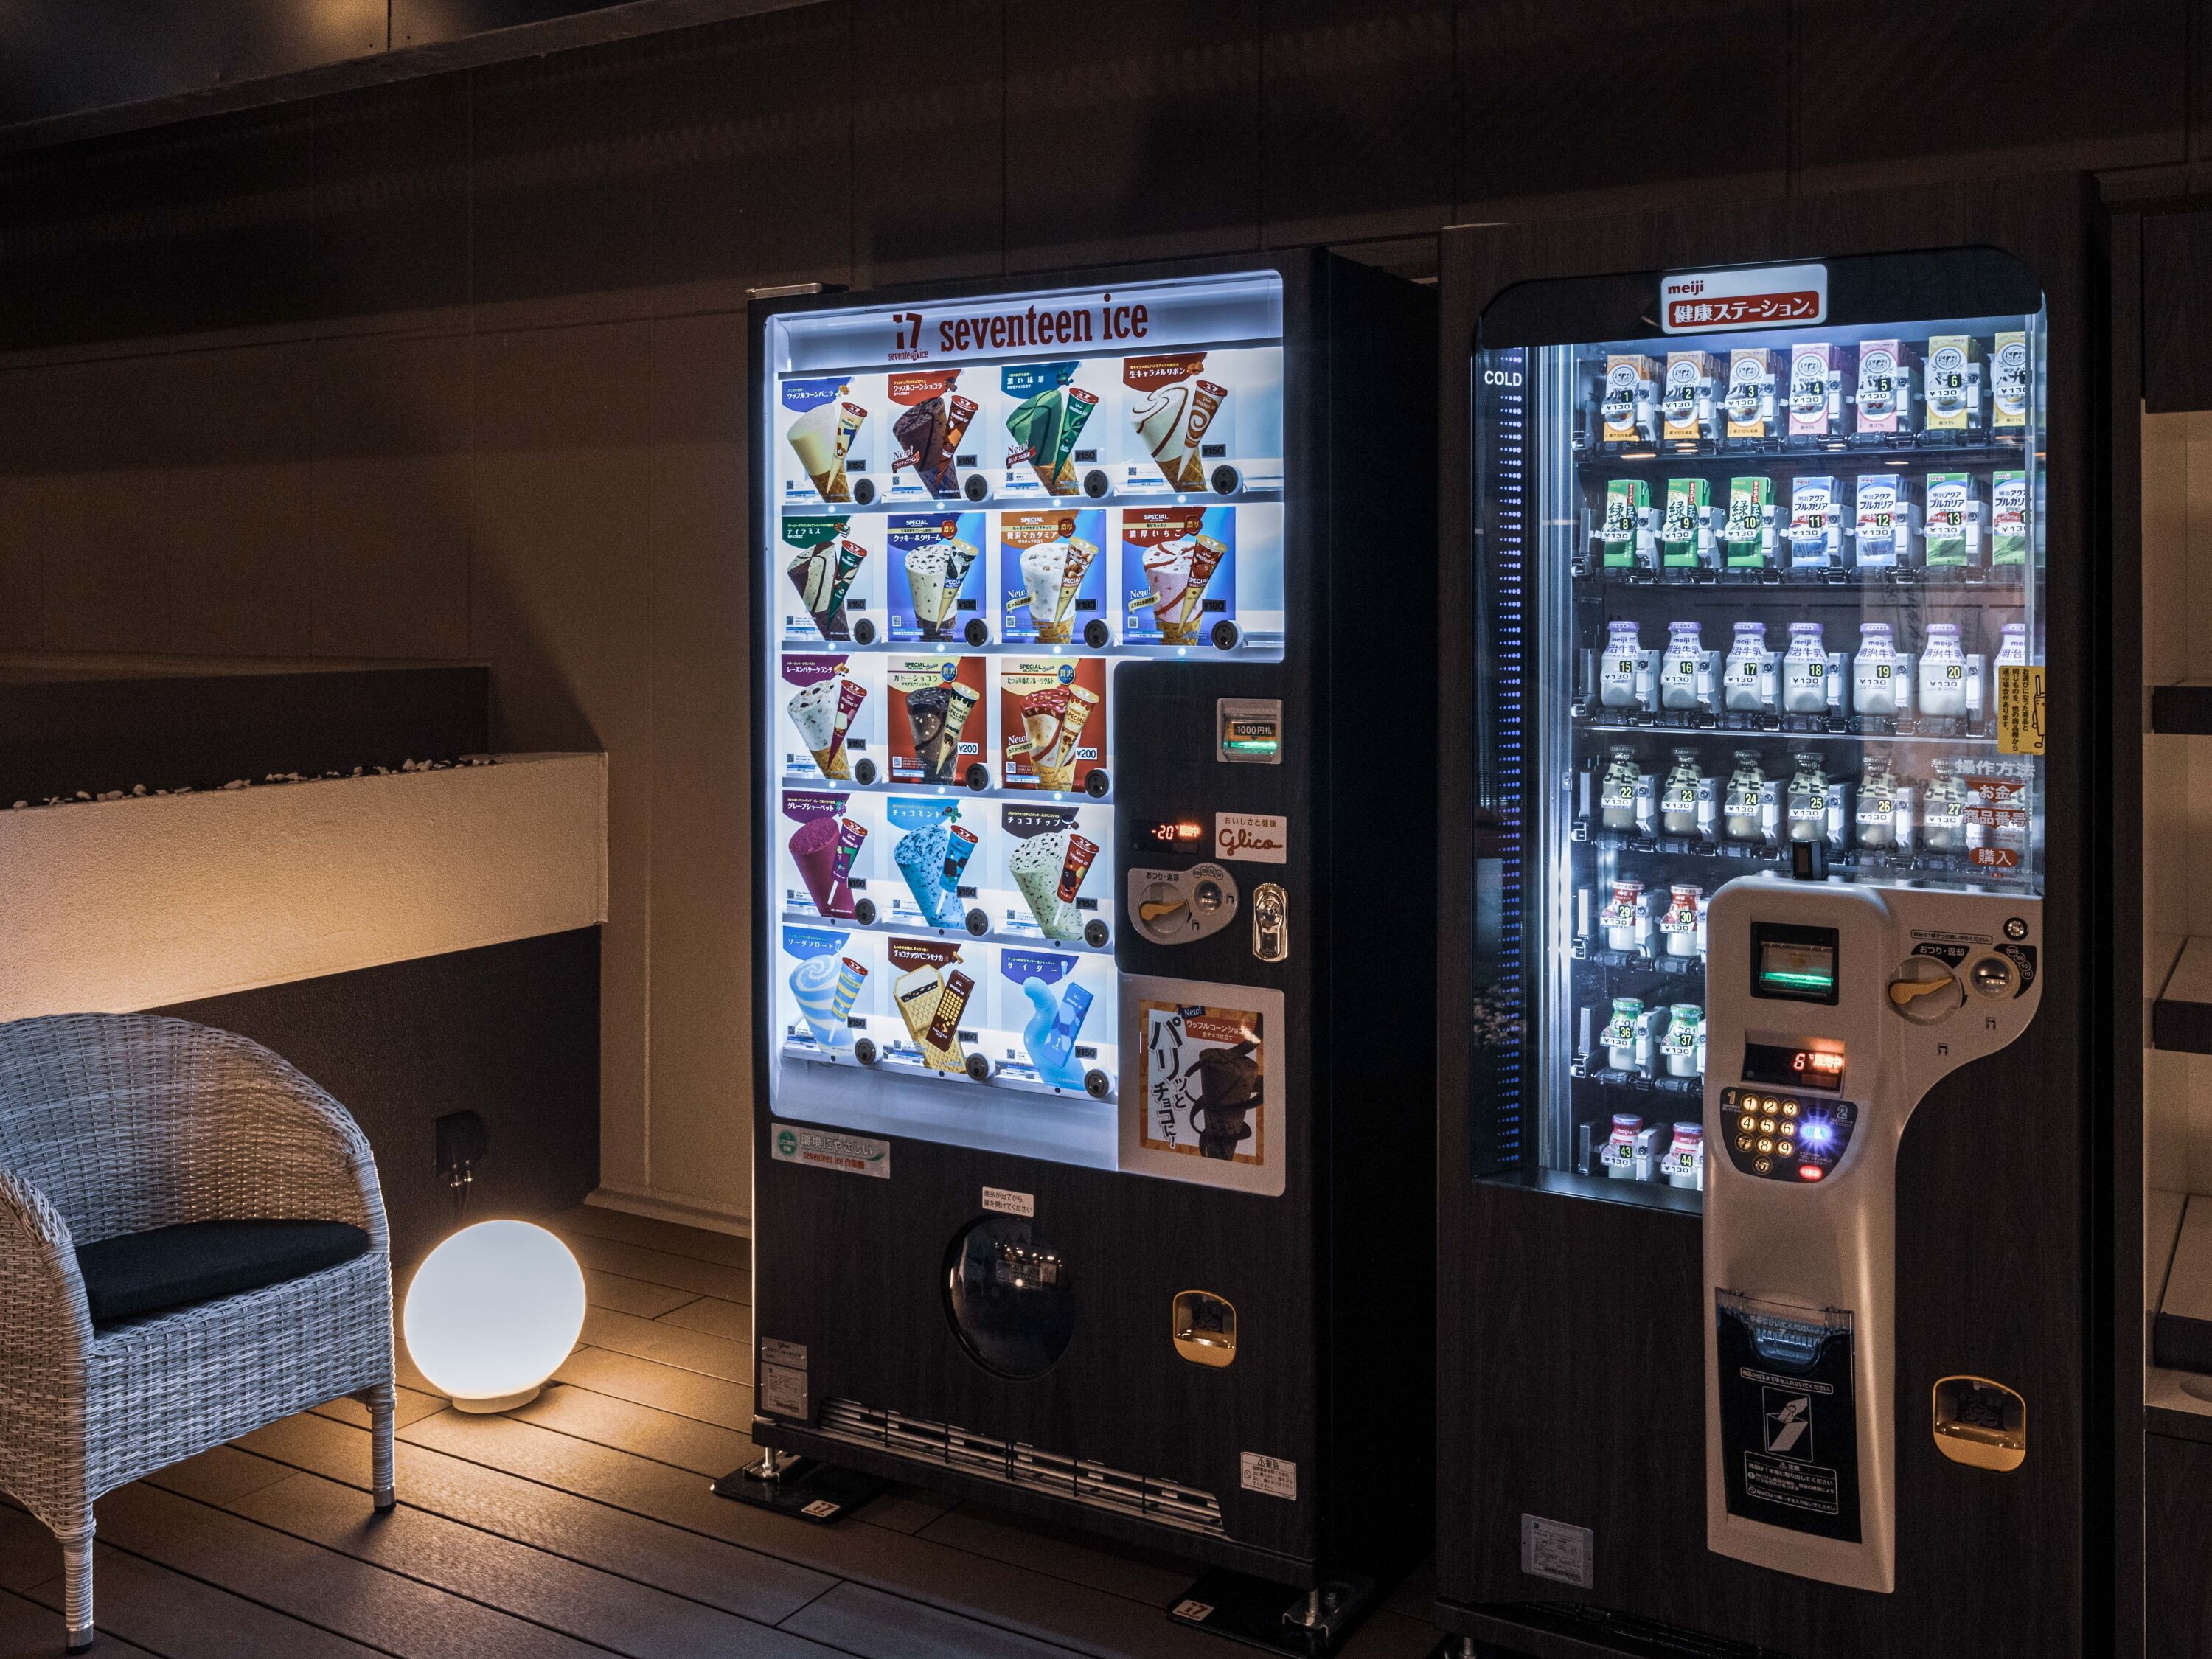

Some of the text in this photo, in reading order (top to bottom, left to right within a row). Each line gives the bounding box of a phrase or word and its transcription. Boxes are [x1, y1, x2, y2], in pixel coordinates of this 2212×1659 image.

[1668, 279, 1704, 295] meiji
[1674, 297, 1809, 324] 健康ステーション
[939, 293, 1148, 352] seventeen ice
[1129, 367, 1186, 378] 生キャラメルリボン
[1484, 370, 1523, 386] COLD
[1881, 379, 1888, 391] 5
[1951, 375, 1958, 386] 6
[1748, 386, 1754, 397] 3
[1813, 383, 1820, 394] 4
[1623, 392, 1630, 403] 1
[1685, 389, 1691, 400] 2
[1606, 403, 1630, 411] ¥130
[894, 445, 914, 461] New!
[1007, 439, 1029, 456] New!
[1203, 447, 1224, 455] ¥150
[1077, 451, 1096, 460] ¥150
[1795, 501, 1828, 511] ブルガリア
[1860, 500, 1893, 509] ブルガリア
[1929, 498, 1964, 508] ブルガリア
[1683, 518, 1689, 529] 9
[1745, 517, 1756, 528] 10
[1810, 516, 1821, 527] 11
[1877, 515, 1889, 526] 12
[1948, 512, 1961, 524] 13
[1622, 519, 1628, 529] 8
[1007, 586, 1028, 599] New!
[1130, 586, 1151, 599] New!
[1077, 600, 1096, 609] ¥180
[1621, 661, 1631, 672] 15
[1681, 662, 1692, 673] 16
[1745, 664, 1756, 675] 17
[1810, 665, 1821, 675] 18
[894, 674, 938, 682] ガトーショコラ
[1877, 667, 1890, 678] 19
[1948, 667, 1960, 678] 20
[2022, 668, 2030, 732] お選びになった商品と
[2011, 668, 2020, 751] 同じものを、他の商品棚から
[1237, 726, 1272, 735] 1000円札
[1008, 733, 1028, 745] New!
[959, 745, 977, 753] ¥200
[1077, 750, 1096, 758] ¥200
[1955, 759, 2036, 777] 操作方法
[1621, 787, 1632, 797] 22
[1682, 790, 1693, 801] 23
[1980, 785, 2011, 801] お金
[1746, 794, 1757, 804] 24
[1811, 797, 1822, 808] 25
[787, 802, 834, 812] グレープシャーベット
[1879, 801, 1891, 812] 26
[1948, 804, 1961, 815] 27
[892, 809, 941, 818] チョコミント
[1964, 809, 2027, 828] 商品番号
[1007, 816, 1061, 826] チョコチップ
[1224, 816, 1276, 828] おいしさと健康
[1151, 825, 1174, 840] -20
[1219, 828, 1284, 857] Glico
[1978, 849, 2011, 866] 購入
[1146, 872, 1180, 881] おつり・返却
[1619, 906, 1630, 917] 29
[1680, 912, 1691, 922] 30
[788, 939, 833, 950] ソーダフロート
[1919, 945, 1964, 956] おつり・返却
[1007, 962, 1057, 972] サイダー
[1184, 1006, 1203, 1017] New!
[1202, 1032, 1234, 1041] 生チョコ仕立て
[1620, 1027, 1631, 1038] 36
[1681, 1035, 1692, 1046] 37
[800, 1133, 873, 1155] 環境にやさしい
[1621, 1147, 1631, 1158] 43
[803, 1151, 865, 1170] seventeen ice 自販機
[1604, 1157, 1628, 1165] ¥130
[1681, 1155, 1692, 1166] 44
[984, 1189, 1023, 1203] 商品が出てから
[984, 1199, 1033, 1213] 扉を開けてください
